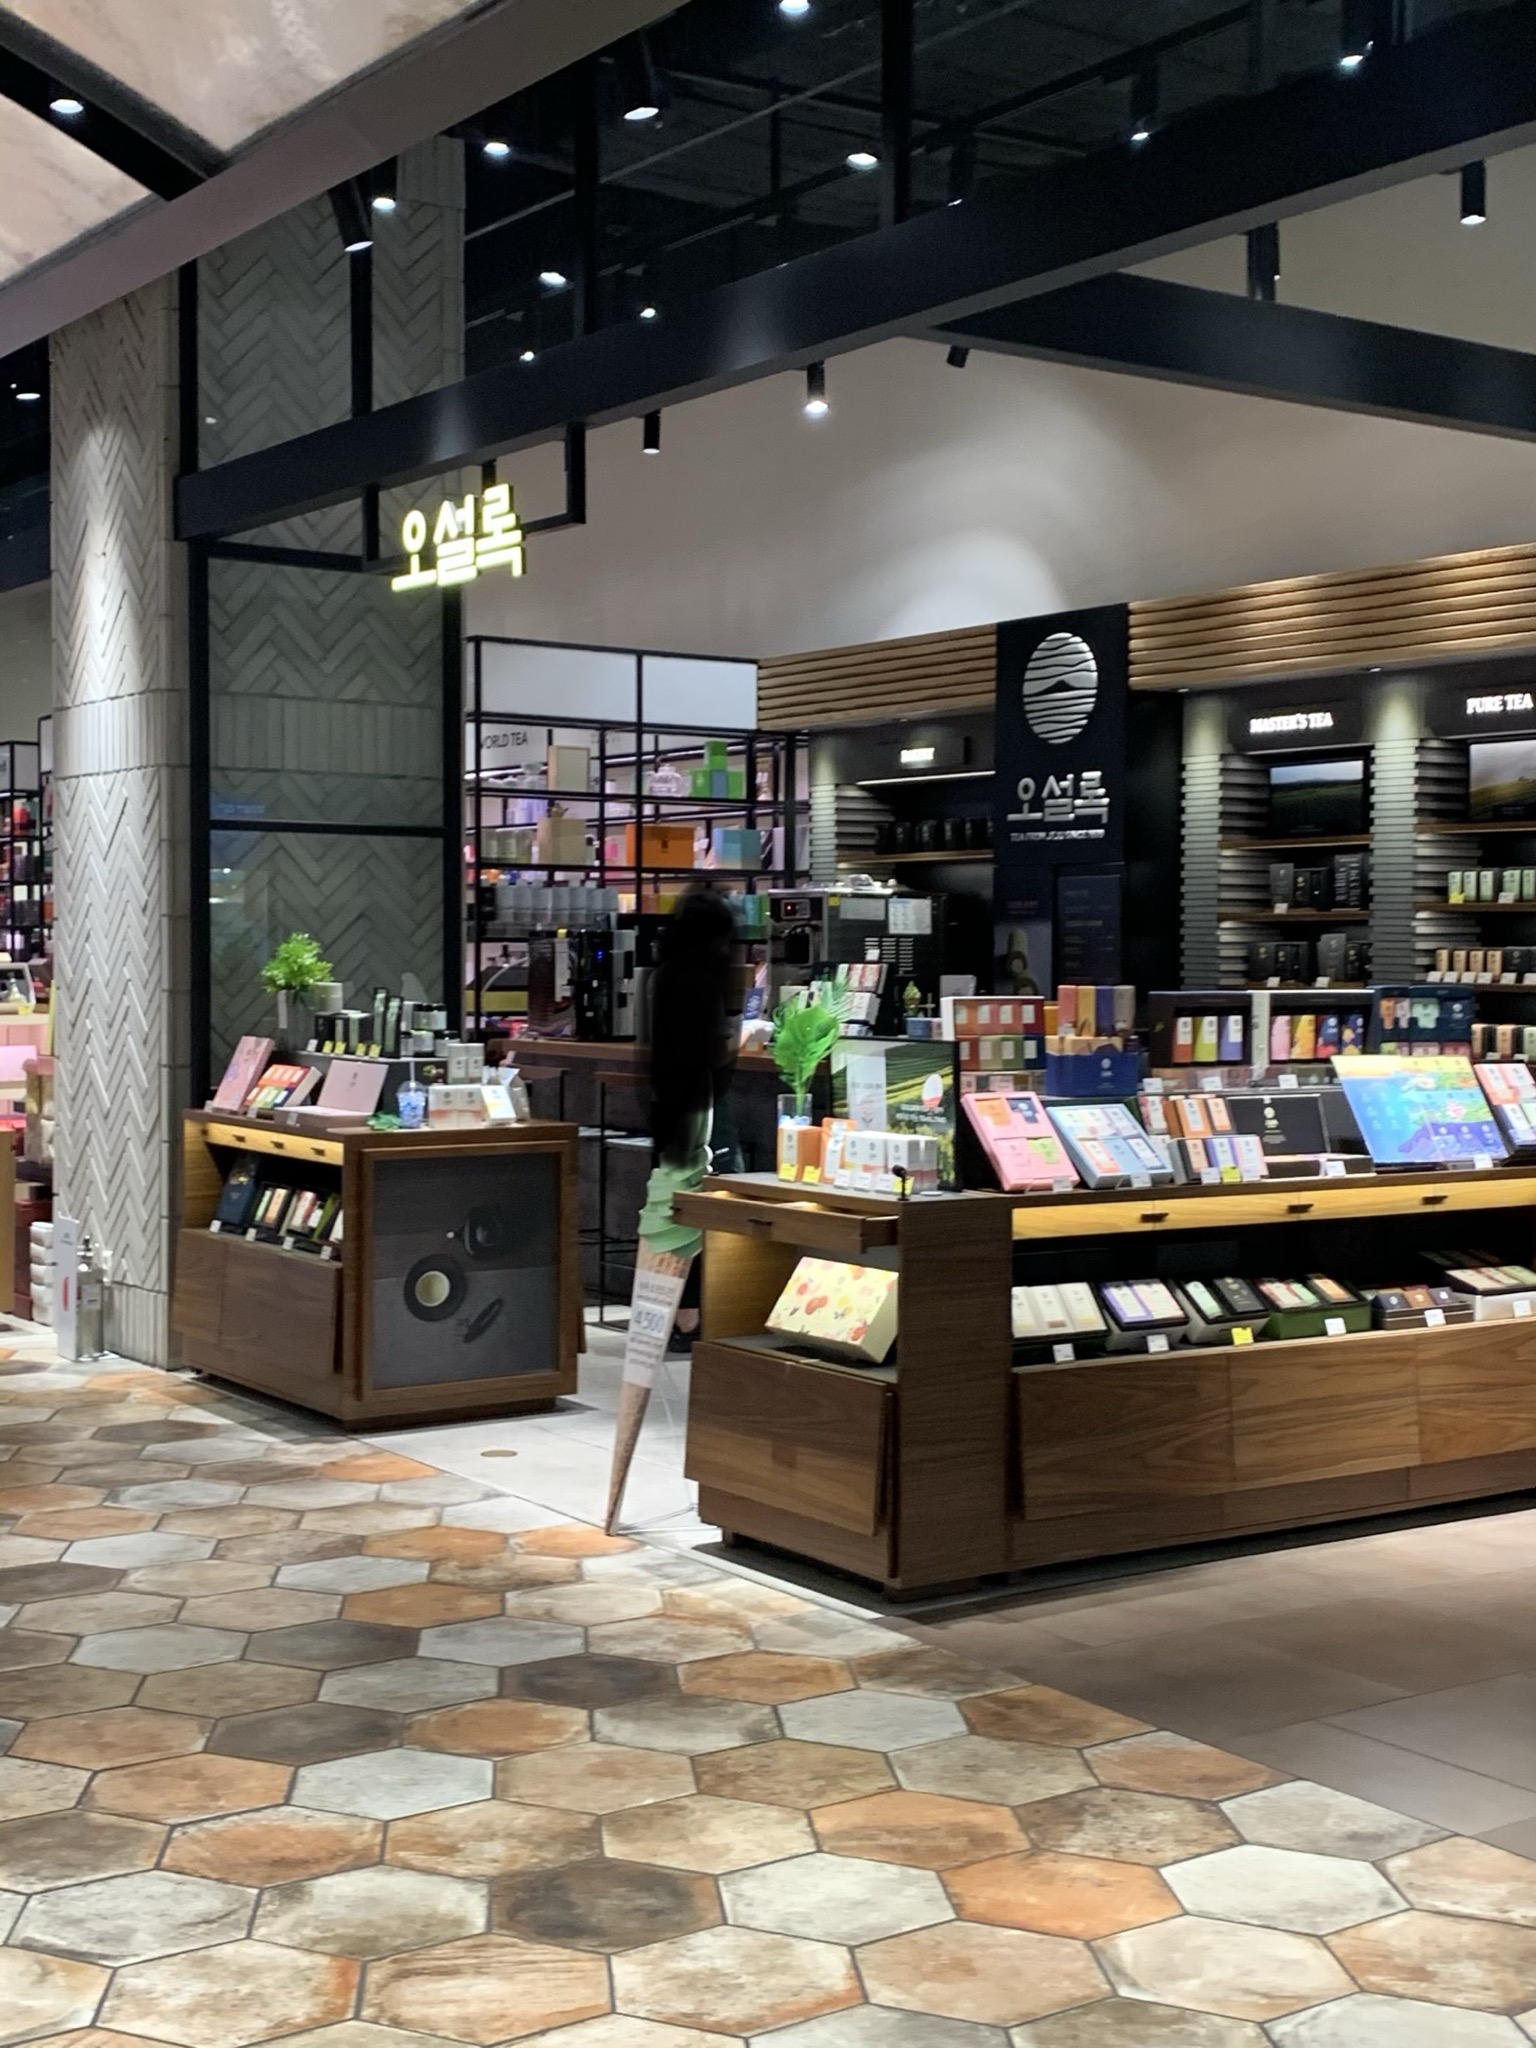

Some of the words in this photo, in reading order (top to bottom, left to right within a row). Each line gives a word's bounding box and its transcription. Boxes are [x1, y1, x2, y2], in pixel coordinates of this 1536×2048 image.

[391, 483, 523, 592] 오설록
[1466, 695, 1504, 715] PURE
[1504, 693, 1534, 711] TEA
[1308, 711, 1334, 730] TEA
[481, 733, 509, 750] ORLD
[510, 731, 529, 746] TEA
[1007, 770, 1111, 824] 오설록
